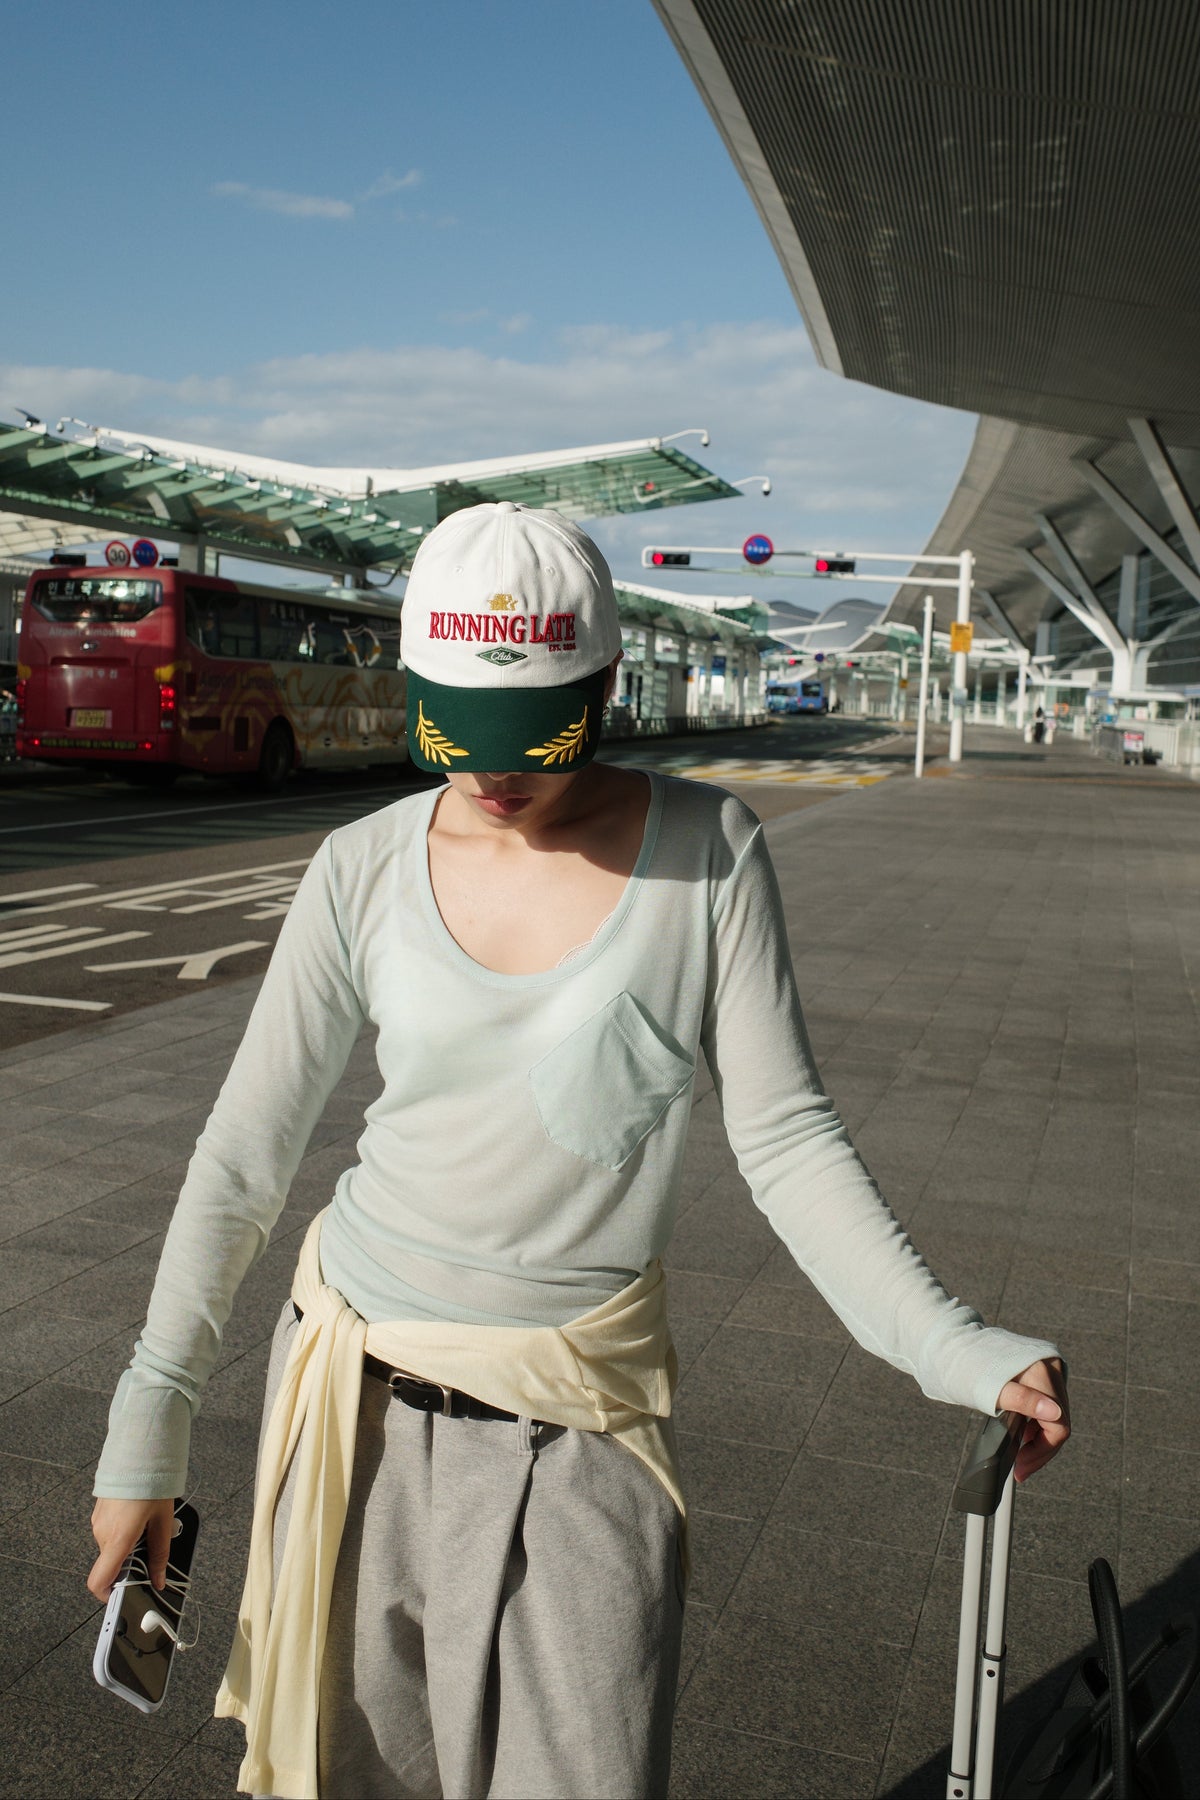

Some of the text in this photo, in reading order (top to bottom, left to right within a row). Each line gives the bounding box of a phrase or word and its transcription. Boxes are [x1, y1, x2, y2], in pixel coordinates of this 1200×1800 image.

[110, 549, 126, 561] 30
[49, 627, 82, 639] Airport
[429, 611, 526, 644] RUNNING
[529, 612, 576, 644] LATE
[490, 651, 514, 661] Club
